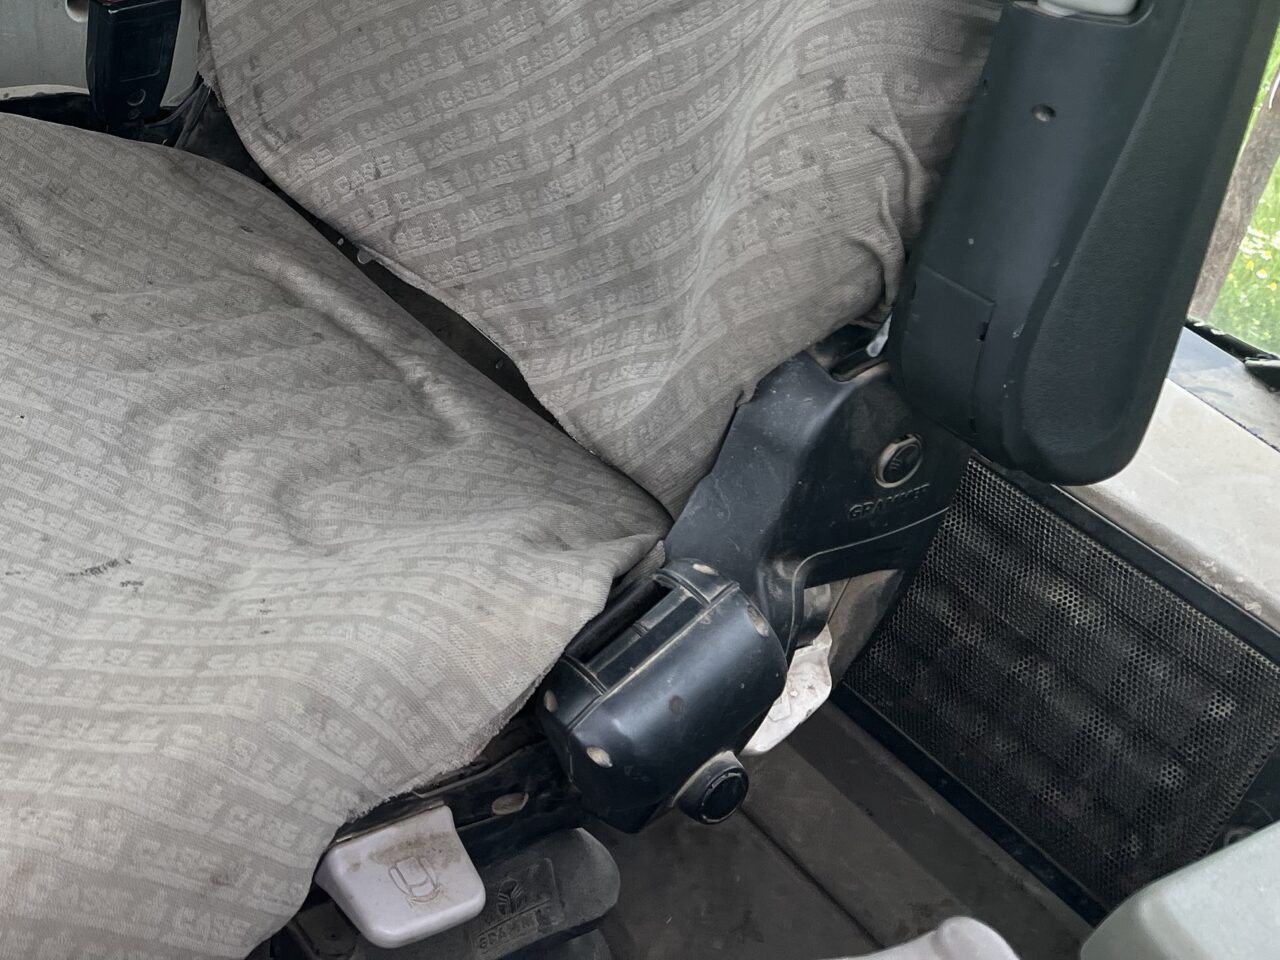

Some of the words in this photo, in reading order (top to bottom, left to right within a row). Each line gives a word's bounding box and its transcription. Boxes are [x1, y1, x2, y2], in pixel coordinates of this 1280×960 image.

[462, 16, 514, 55] CASE
[654, 1, 712, 40] CASE
[804, 18, 922, 59] CASE
[377, 53, 433, 90] CASE
[517, 32, 569, 74] CASE
[571, 46, 622, 93] CASE
[438, 74, 492, 109] CASE
[623, 64, 676, 108] CASE
[357, 106, 415, 137] CASE
[492, 94, 547, 132] CASE
[676, 85, 720, 132] CASE
[423, 127, 469, 158] CASE
[596, 126, 646, 168] CASE
[473, 151, 524, 182] CASE
[649, 156, 692, 191] CASE
[393, 178, 454, 209] CASE
[525, 170, 575, 208] CASE
[457, 198, 503, 229] CASE
[507, 227, 553, 258] CASE
[629, 220, 672, 260] CASE
[554, 251, 605, 282] CASE
[36, 450, 120, 489] CASE
[3, 498, 91, 538] CASE
[60, 646, 161, 668] CASE
[208, 650, 317, 674] CASE
[109, 685, 216, 704] CASE
[12, 714, 120, 740] CASE
[172, 724, 279, 780] CASE
[68, 764, 184, 810] CASE
[226, 805, 307, 852] CASE
